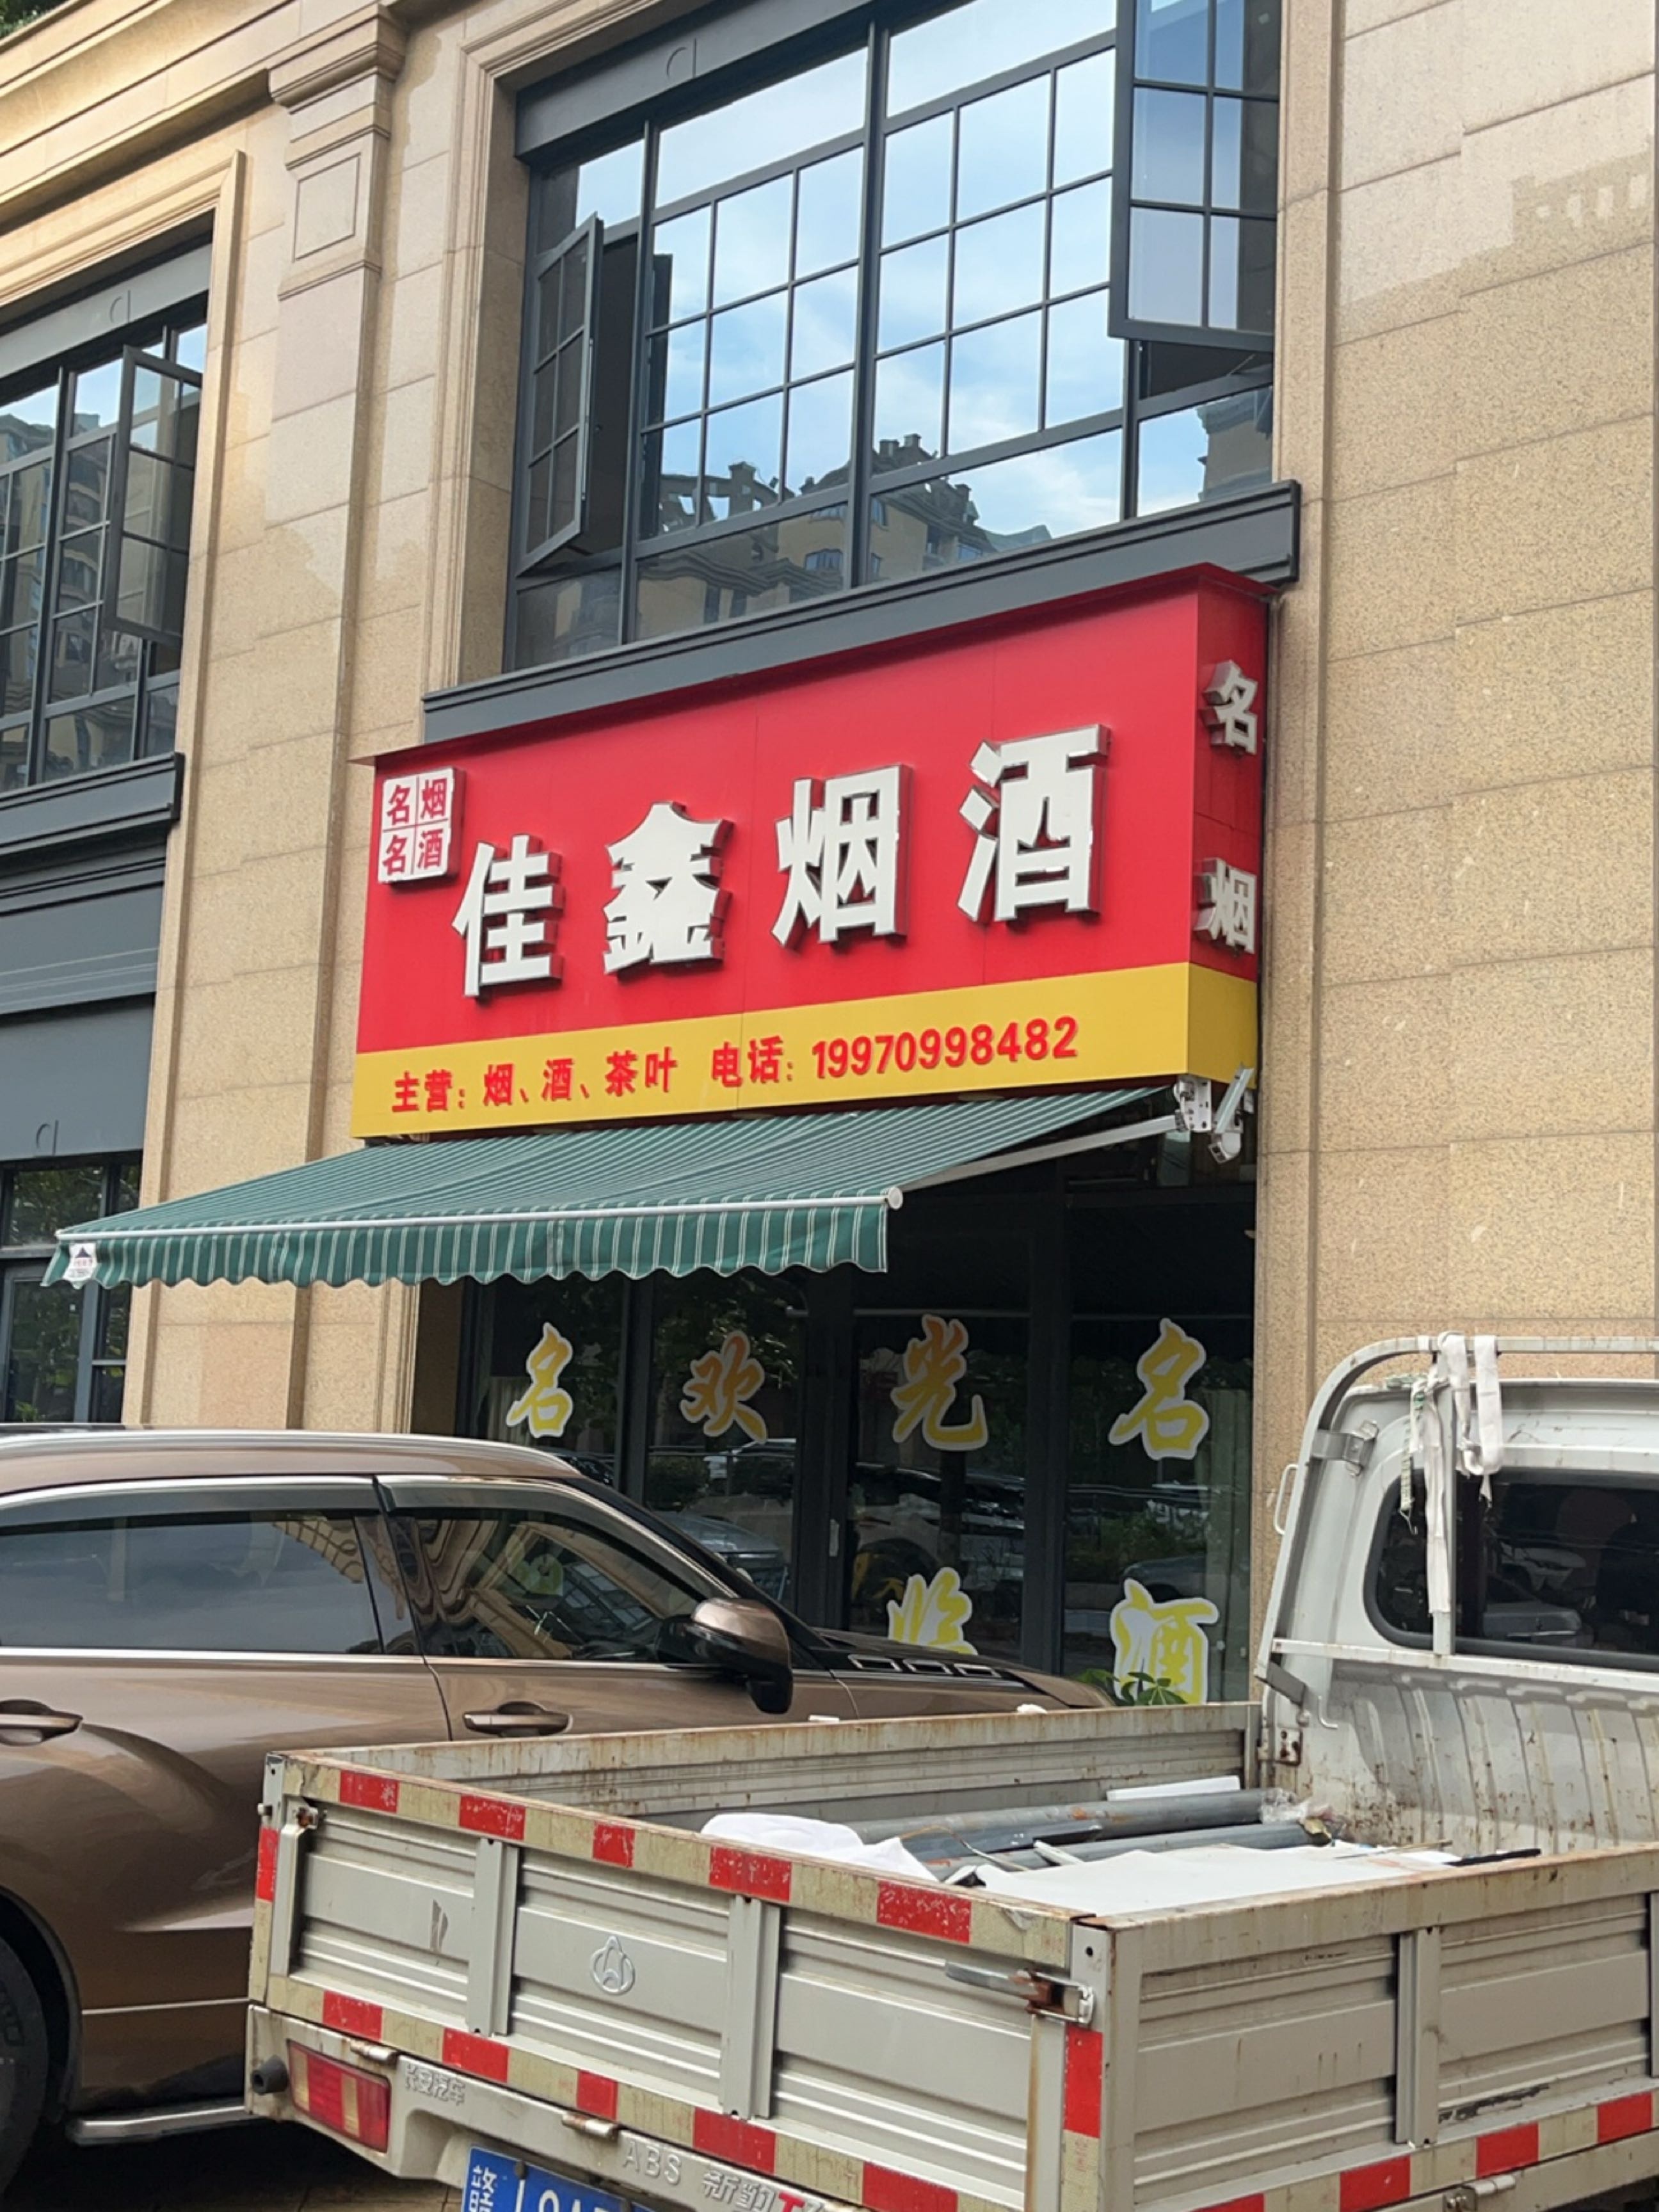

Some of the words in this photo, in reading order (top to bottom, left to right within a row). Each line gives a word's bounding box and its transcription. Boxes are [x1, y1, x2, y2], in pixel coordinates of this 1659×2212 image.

[387, 778, 447, 825] 名烟
[383, 829, 444, 875] 名酒
[451, 724, 1105, 998] 佳鑫烟酒
[623, 2139, 682, 2186] ABS
